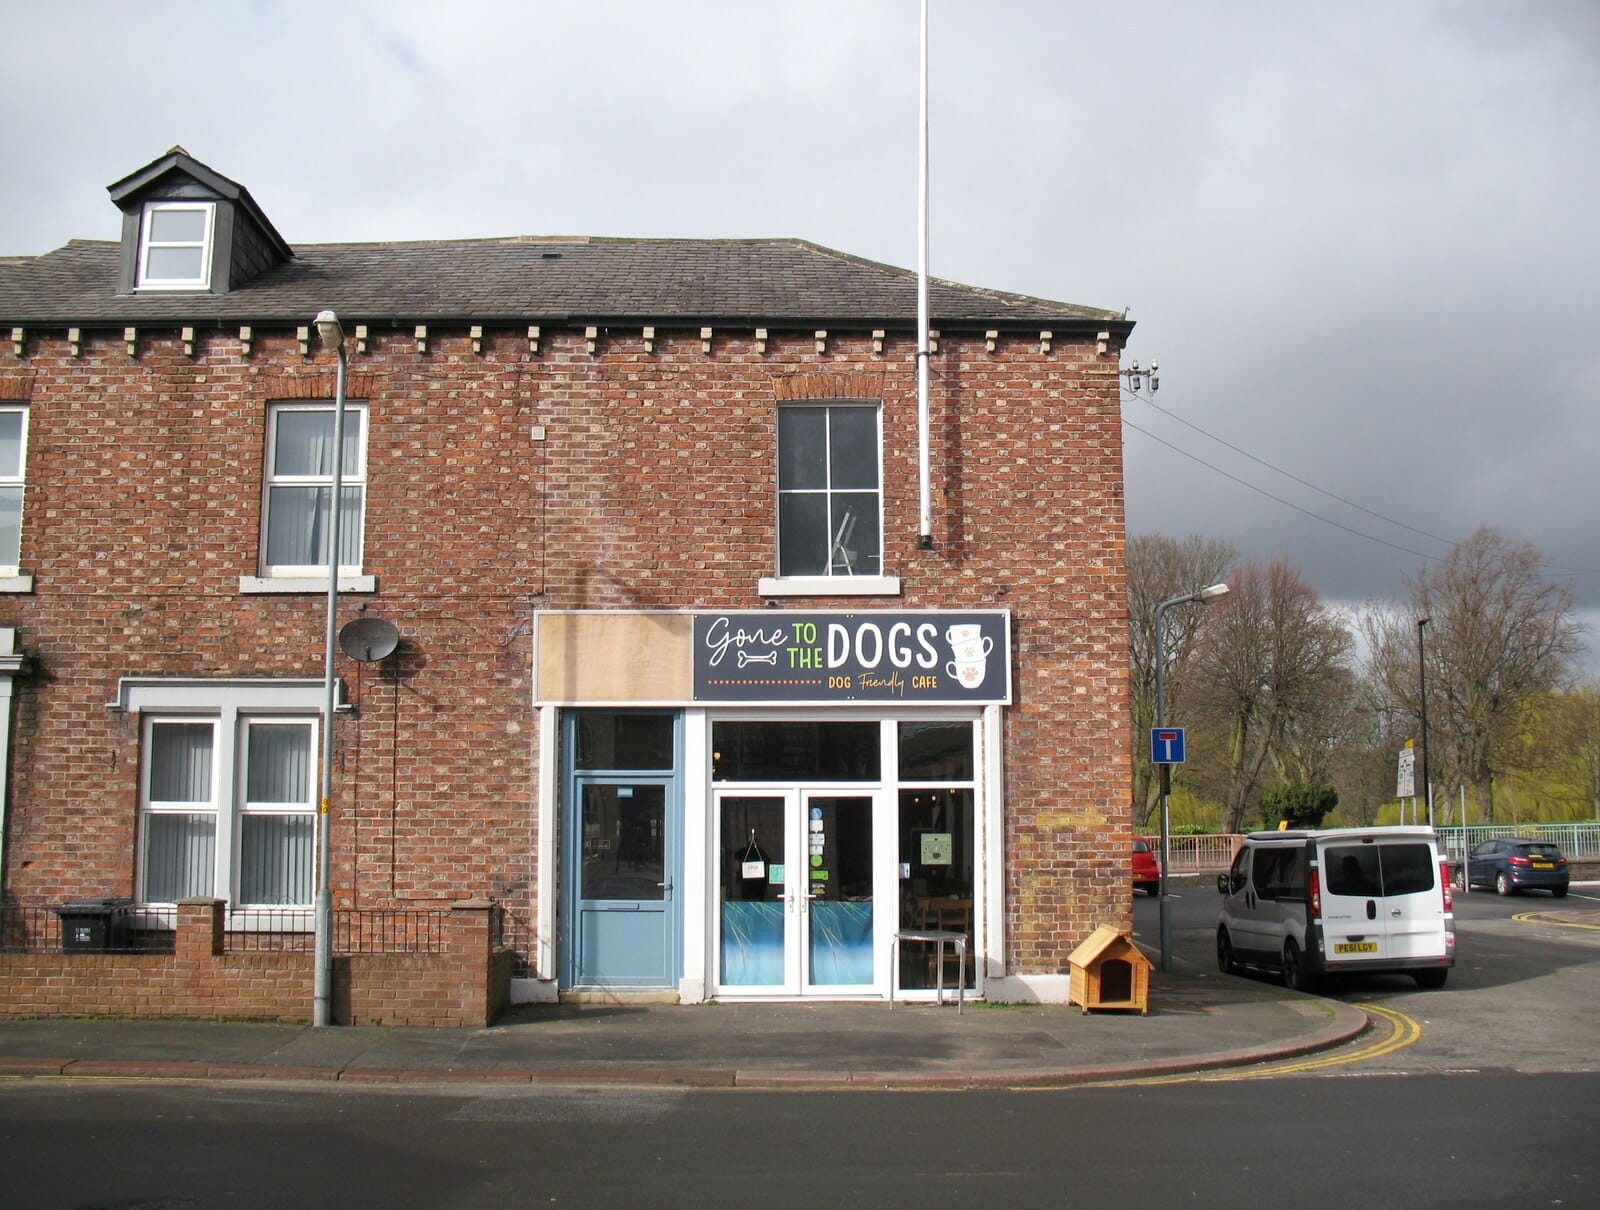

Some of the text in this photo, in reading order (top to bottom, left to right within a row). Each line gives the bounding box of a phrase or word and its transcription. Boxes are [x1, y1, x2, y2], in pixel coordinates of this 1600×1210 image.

[706, 617, 939, 669] Gone TO THE DOGS
[828, 671, 938, 697] DOG Friendly CAFE
